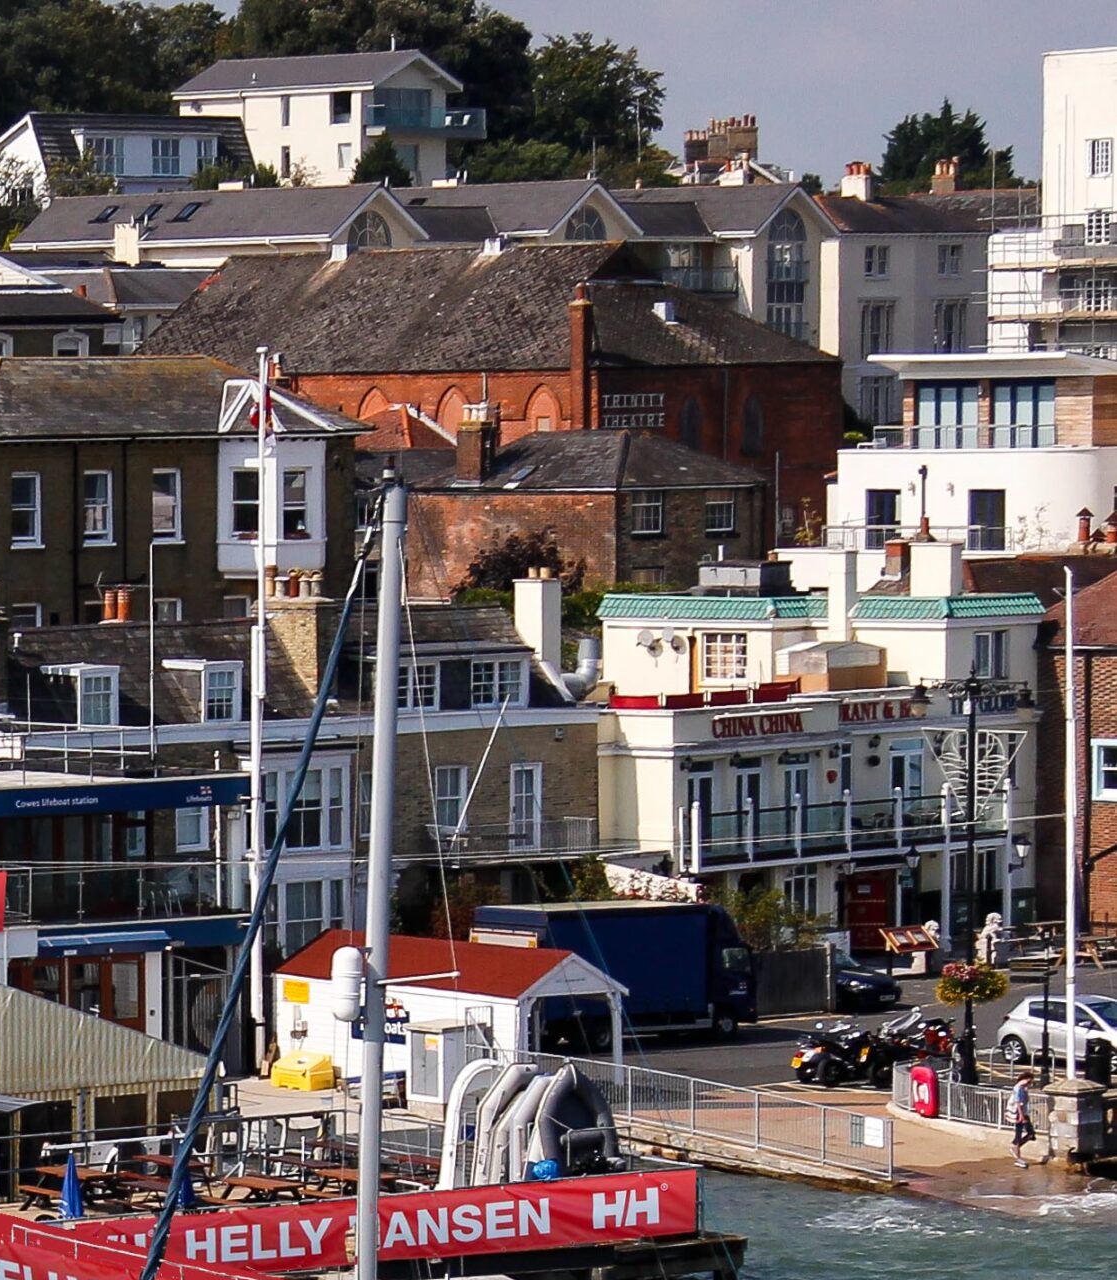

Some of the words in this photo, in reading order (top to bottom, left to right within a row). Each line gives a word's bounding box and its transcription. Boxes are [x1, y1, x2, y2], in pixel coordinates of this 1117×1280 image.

[602, 392, 665, 408] TRINITY
[603, 412, 666, 428] THEATRE
[712, 714, 758, 739] CHINA
[760, 711, 804, 735] CHINA
[185, 1217, 333, 1264] HELLY
[377, 1197, 551, 1250] ANSEN
